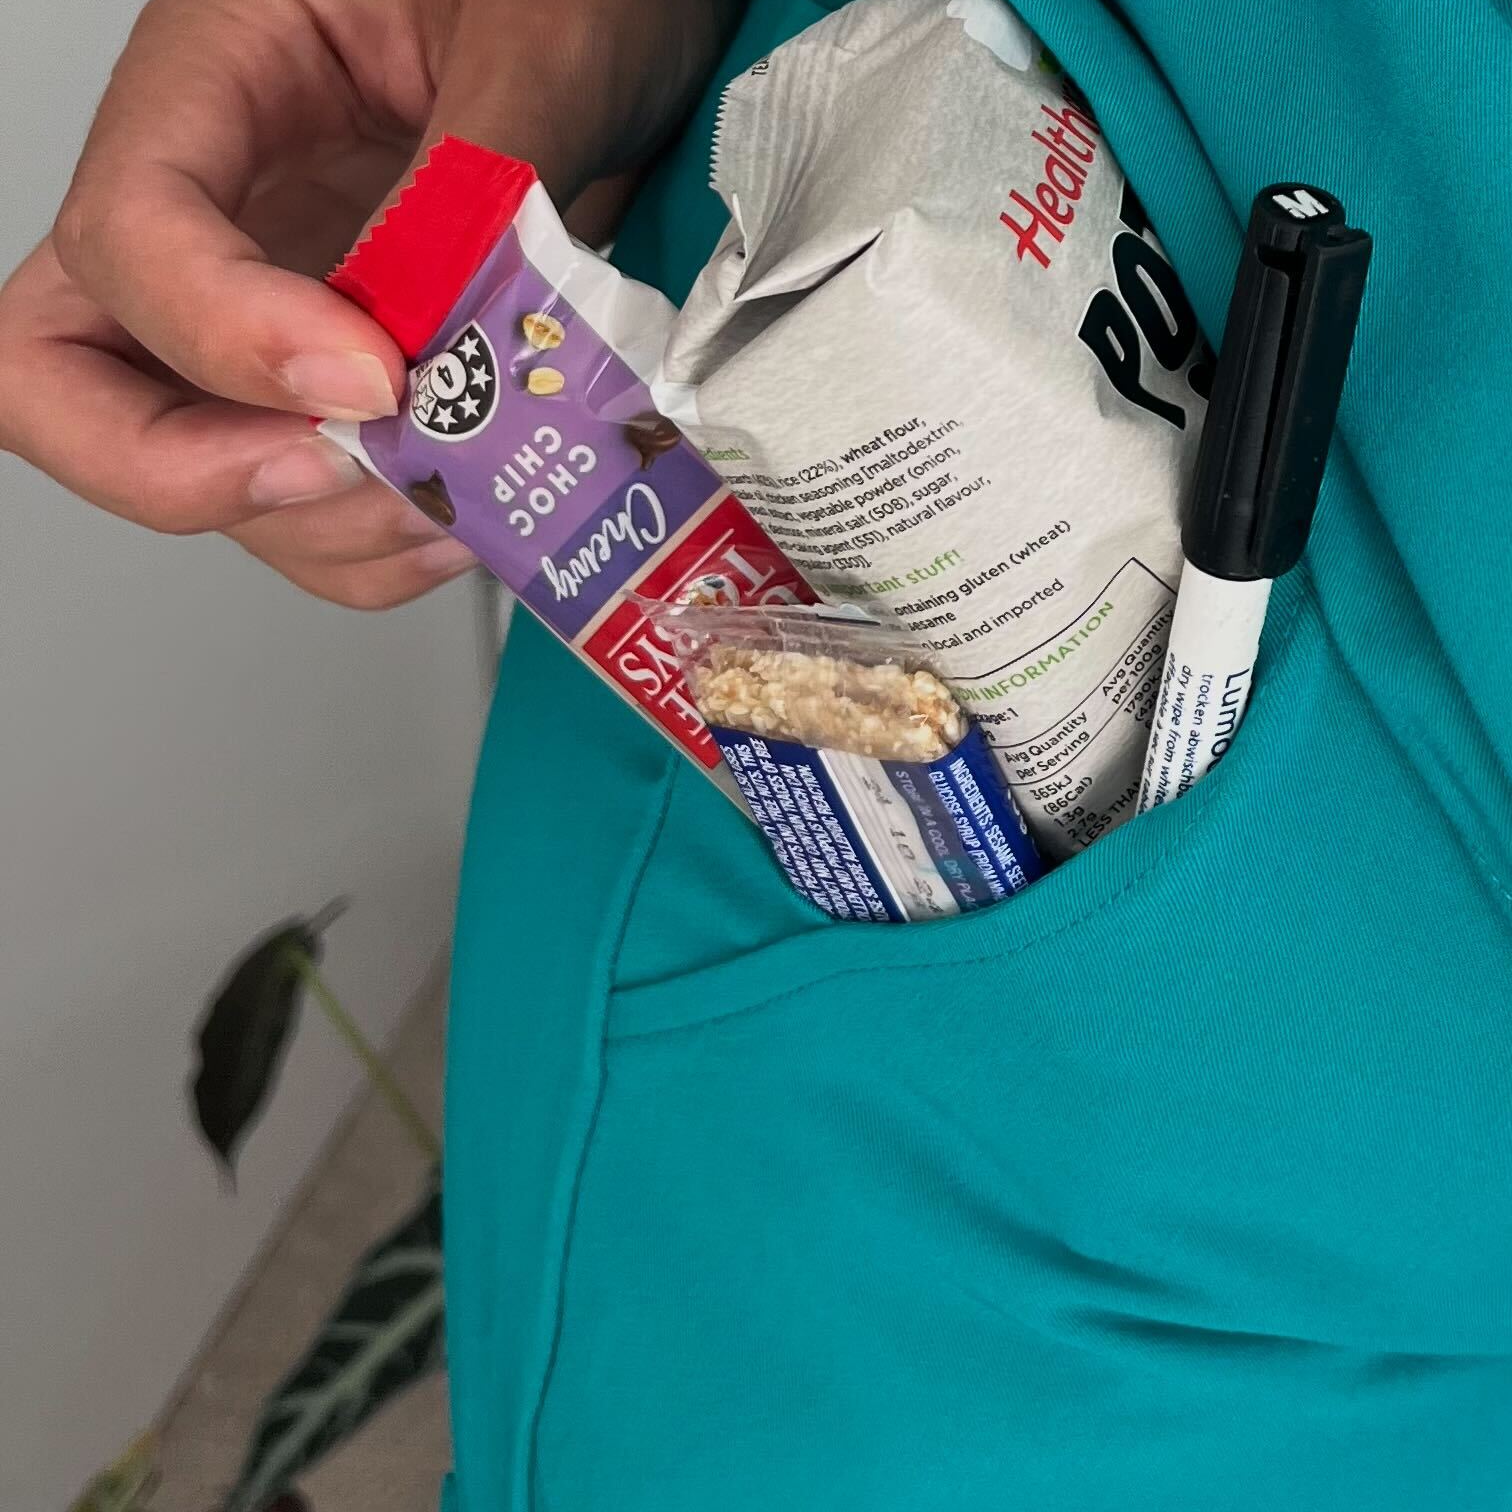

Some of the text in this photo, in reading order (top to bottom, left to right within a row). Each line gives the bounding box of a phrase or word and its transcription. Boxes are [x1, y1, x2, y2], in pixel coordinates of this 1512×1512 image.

[437, 364, 455, 387] 4
[493, 425, 563, 503] CHIP
[840, 436, 887, 464] wheat
[883, 417, 927, 443] flour,
[509, 443, 597, 537] CHOC
[798, 498, 855, 523] vegetable
[854, 473, 908, 507] powder
[907, 446, 961, 480] (onion,
[799, 471, 865, 502] seasoning
[805, 519, 847, 538] mineral
[845, 514, 871, 531] salt
[868, 496, 915, 522] (508),
[911, 472, 959, 501] sugar,
[823, 538, 855, 556] agent
[886, 505, 937, 537] natural
[934, 476, 992, 512] flavour,
[541, 482, 667, 602] Chewy
[906, 549, 965, 585] stuff!
[894, 520, 1071, 617] ontaining gluten (wheat)
[927, 578, 1064, 651] local and imported
[981, 601, 1114, 701] INFORMATION
[1111, 644, 1163, 705] per 100g
[1102, 668, 1126, 696] Avg
[1177, 665, 1193, 689] dry
[1193, 673, 1215, 726] trocken
[1171, 692, 1186, 726] wipe
[1206, 668, 1250, 773] Lumo
[732, 744, 758, 765] THIS
[747, 737, 772, 757] BEE
[1003, 711, 1088, 764] Avg Quantity
[1015, 731, 1090, 781] per Serving
[1163, 729, 1182, 763] from
[758, 758, 778, 772] OF
[778, 764, 802, 785] CAN
[1029, 774, 1073, 801] 365kJ
[927, 771, 965, 816] GLUCOSE
[950, 816, 982, 849] SYRUP
[946, 756, 997, 830] INGREDIENTS:
[982, 822, 1018, 870] SESAME
[1043, 776, 1093, 816] (86Cal)
[1078, 779, 1142, 847] LESS THA
[807, 856, 833, 878] MAY
[954, 882, 980, 906] PLAC
